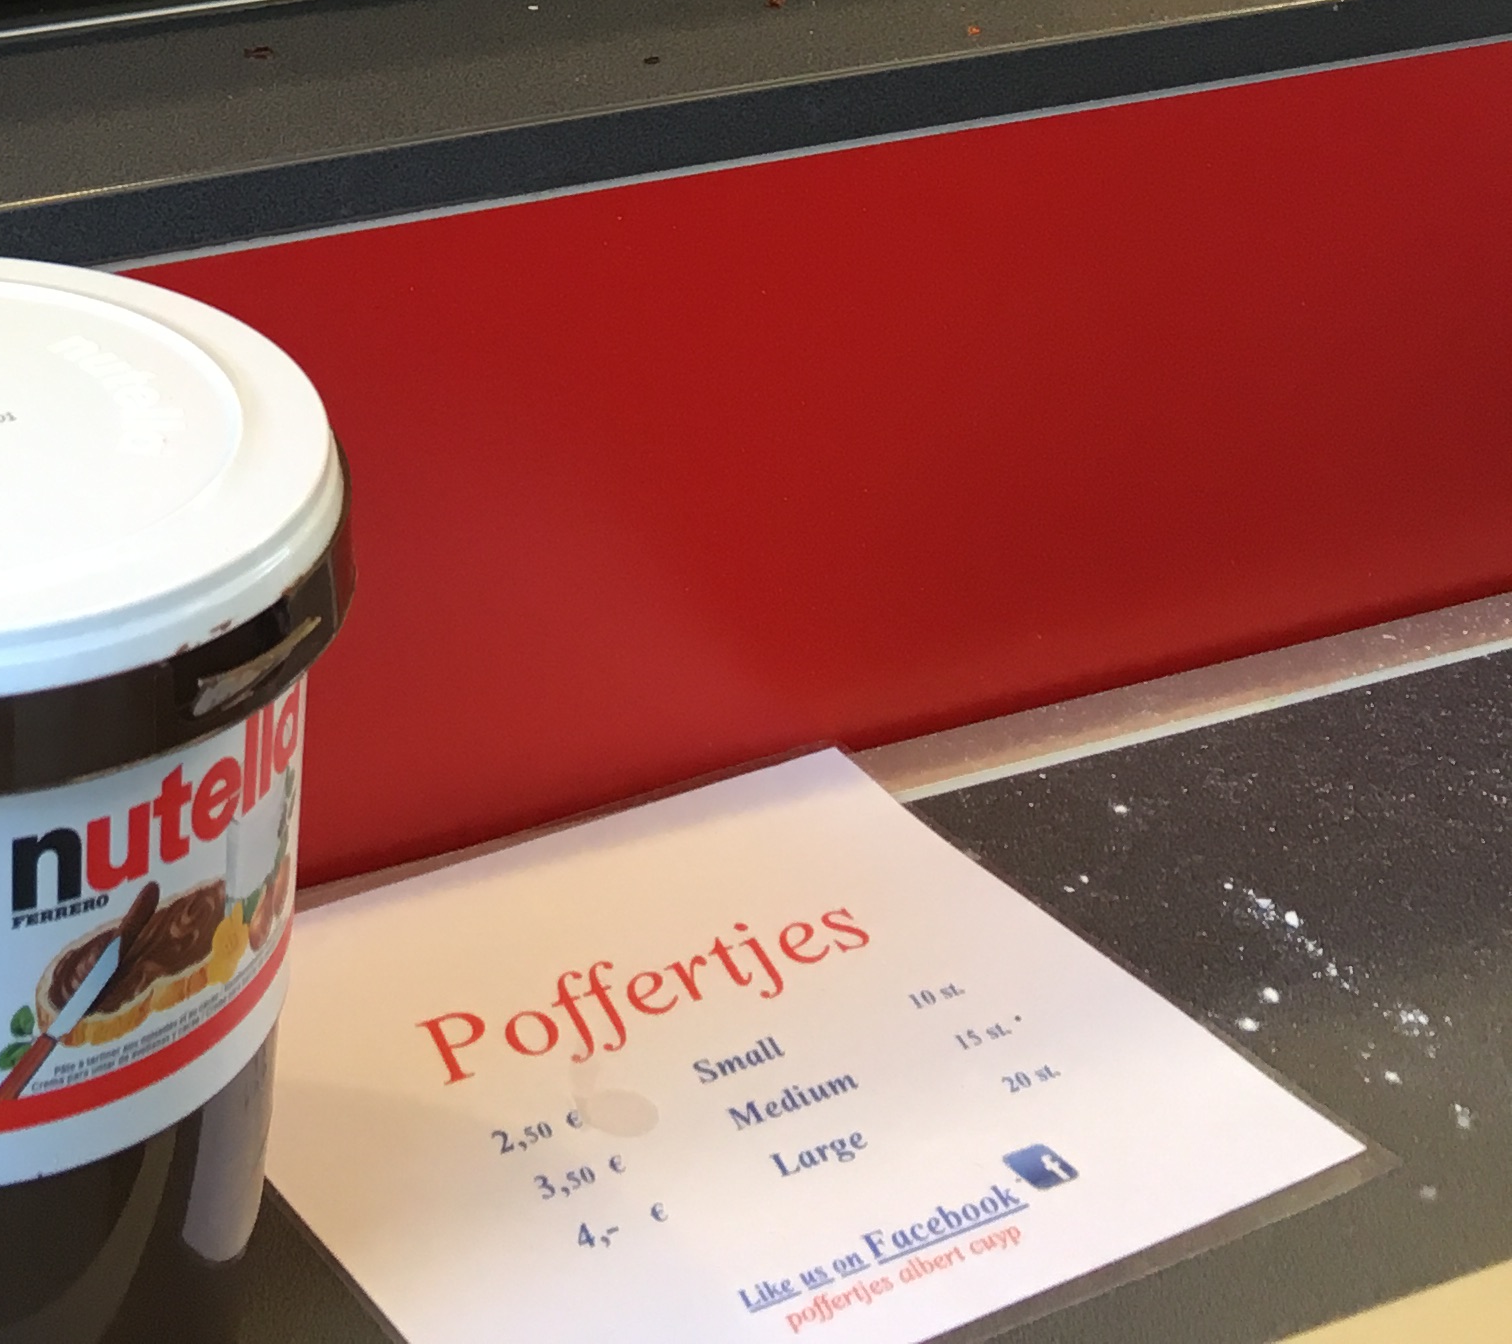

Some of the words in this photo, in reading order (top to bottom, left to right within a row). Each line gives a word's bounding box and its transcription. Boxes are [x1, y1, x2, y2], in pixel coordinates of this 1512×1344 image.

[12, 680, 300, 912] nutella
[12, 894, 109, 929] FERRERO
[415, 907, 870, 1086] Poffertjes
[491, 1121, 553, 1155] 2,50
[692, 1035, 786, 1084] Small
[908, 989, 936, 1009] 10
[533, 1166, 596, 1200] 3,50
[726, 1074, 859, 1131] Medium
[955, 1029, 983, 1050] 15
[769, 1131, 868, 1177] Large
[1001, 1071, 1032, 1093] 20
[737, 1276, 802, 1313] Like
[799, 1264, 836, 1290] us
[832, 1249, 871, 1279] on
[860, 1184, 1030, 1265] Facebook
[785, 1273, 894, 1334] poffertjes
[899, 1244, 966, 1284] albert
[969, 1224, 1022, 1256] cuyp
